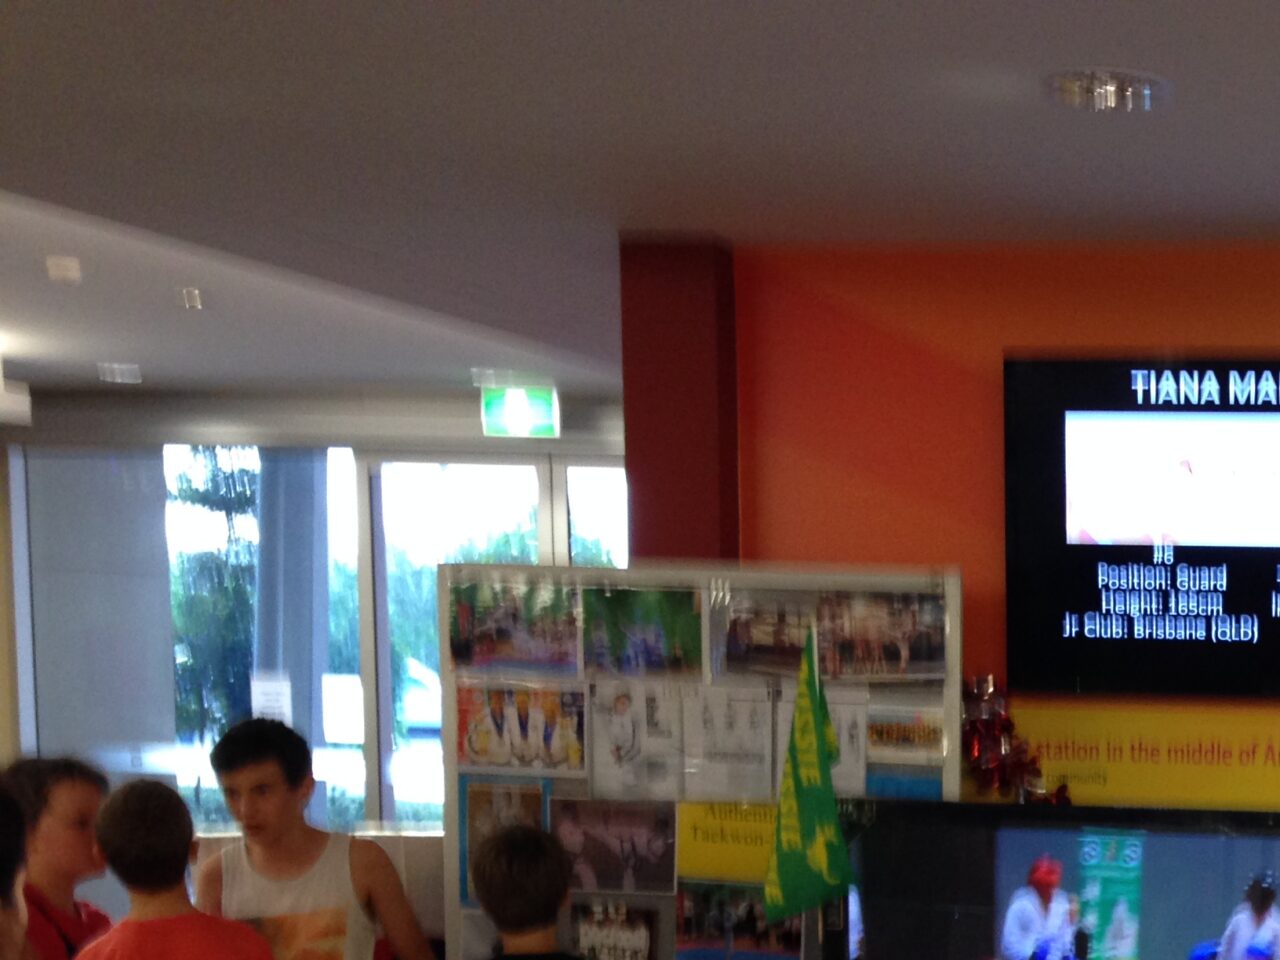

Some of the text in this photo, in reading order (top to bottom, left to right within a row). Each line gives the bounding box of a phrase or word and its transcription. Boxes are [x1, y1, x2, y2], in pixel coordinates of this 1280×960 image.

[1131, 370, 1220, 405] TIANA
[1098, 563, 1228, 591] Position: Guard
[1102, 589, 1223, 617] Height: 165cm
[1084, 612, 1128, 639] Club:
[1134, 614, 1206, 640] Brisbane
[1211, 615, 1259, 644] (QLD)
[1107, 739, 1123, 763] in
[1131, 738, 1160, 764] the
[1168, 740, 1233, 767] middle
[1239, 740, 1257, 767] of
[705, 802, 777, 825] Authenti
